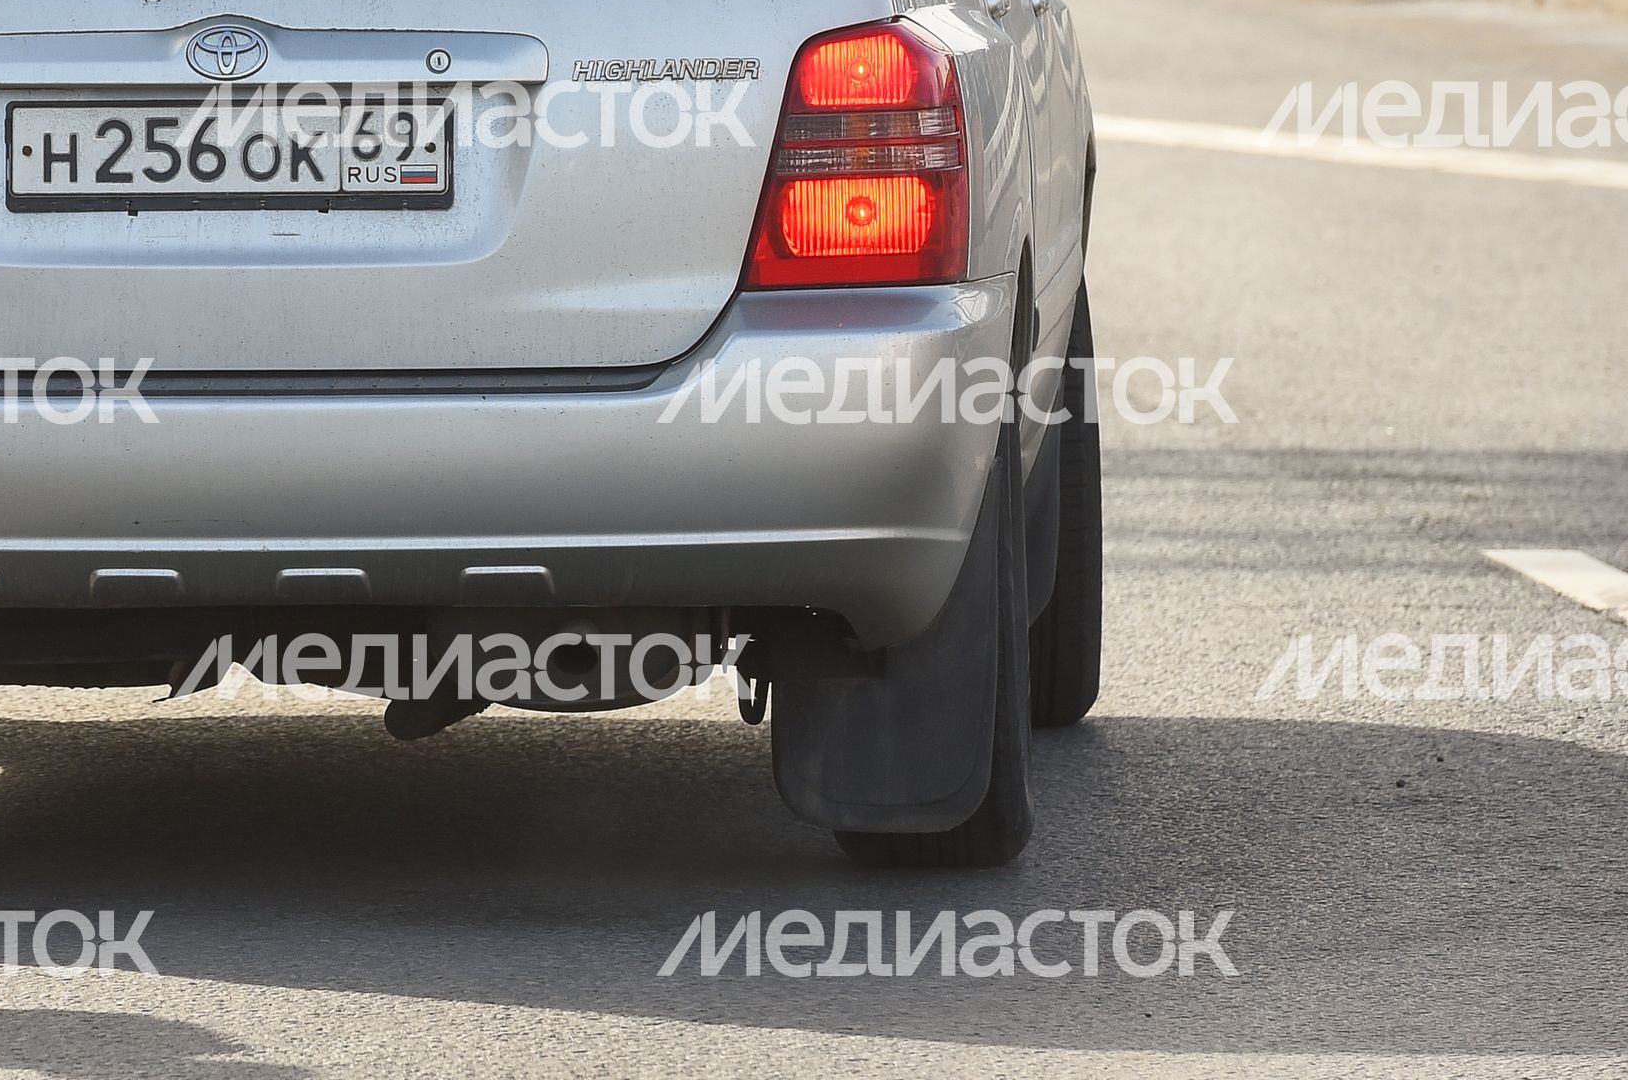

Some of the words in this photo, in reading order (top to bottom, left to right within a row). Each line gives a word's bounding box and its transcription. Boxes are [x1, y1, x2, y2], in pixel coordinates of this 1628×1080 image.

[572, 57, 761, 81] HIGHLANDER
[351, 110, 419, 161] 69
[347, 165, 397, 184] RUS
